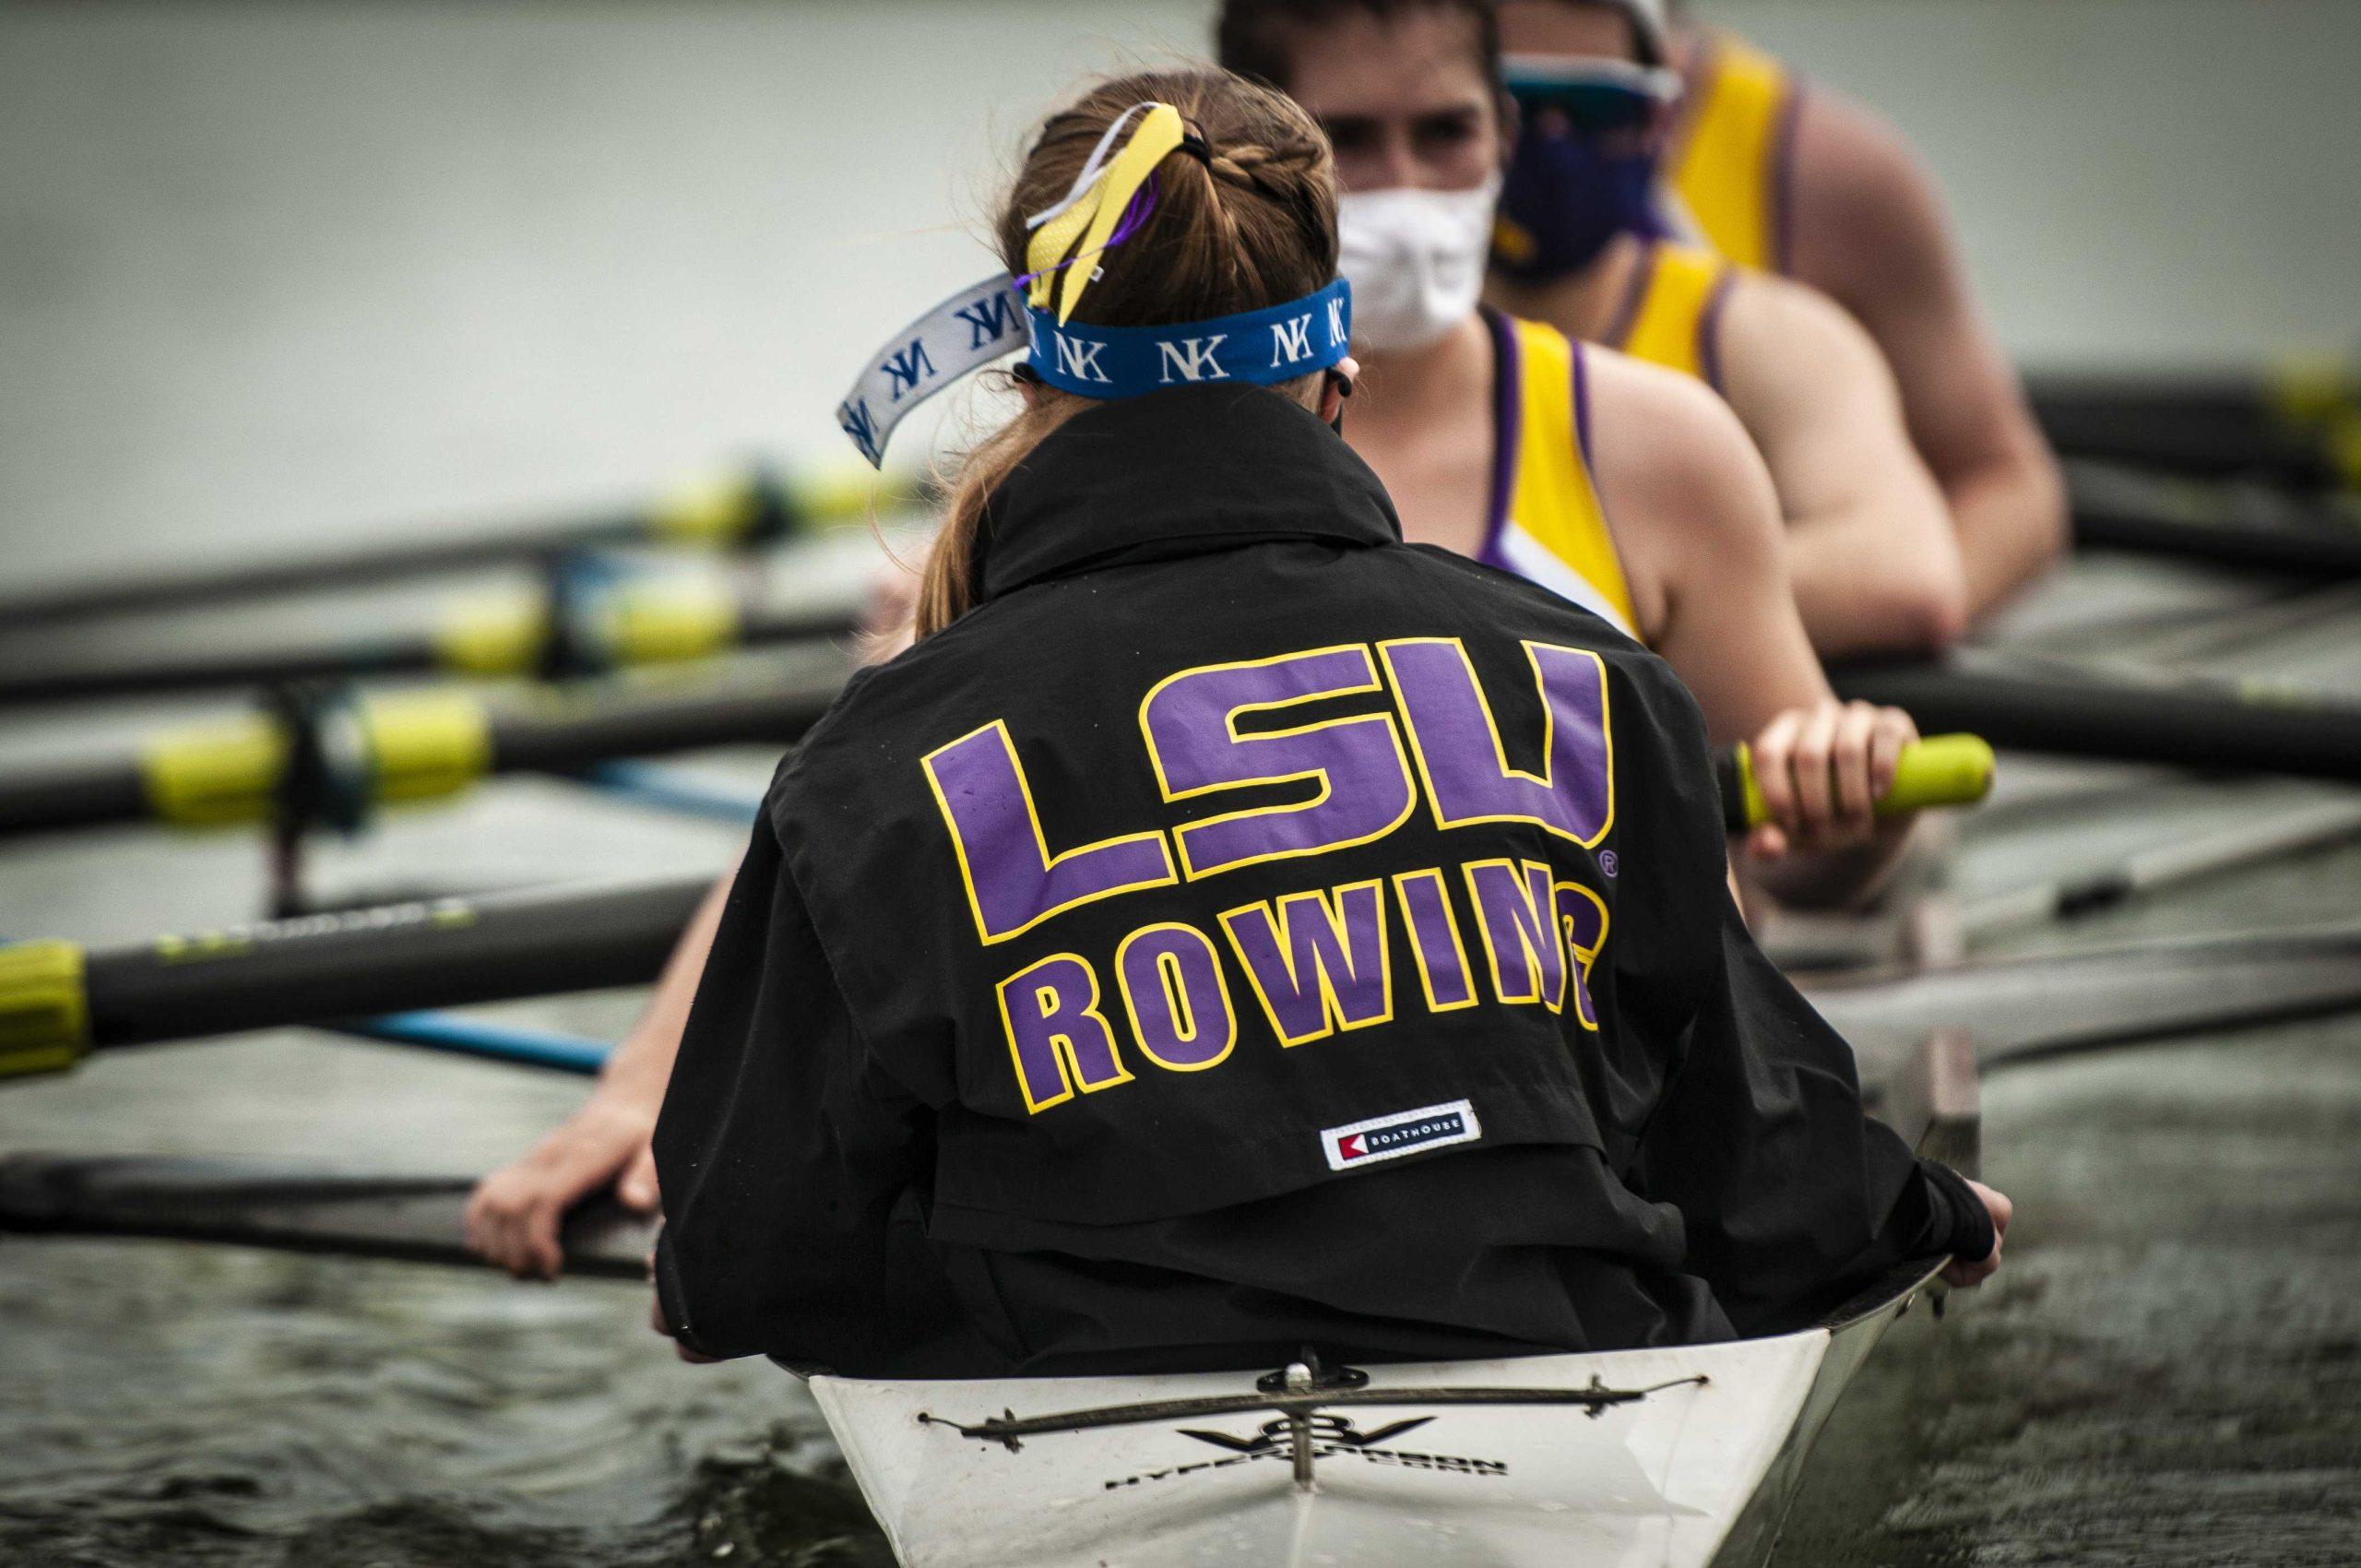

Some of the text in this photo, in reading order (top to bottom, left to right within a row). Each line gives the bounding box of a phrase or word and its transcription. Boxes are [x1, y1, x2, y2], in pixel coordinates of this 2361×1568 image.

[1052, 330, 1113, 384] NK
[1156, 334, 1231, 384] NK
[1269, 313, 1314, 368] NK
[921, 636, 1615, 946] LSU
[1370, 1118, 1461, 1146] BOATHOUSE
